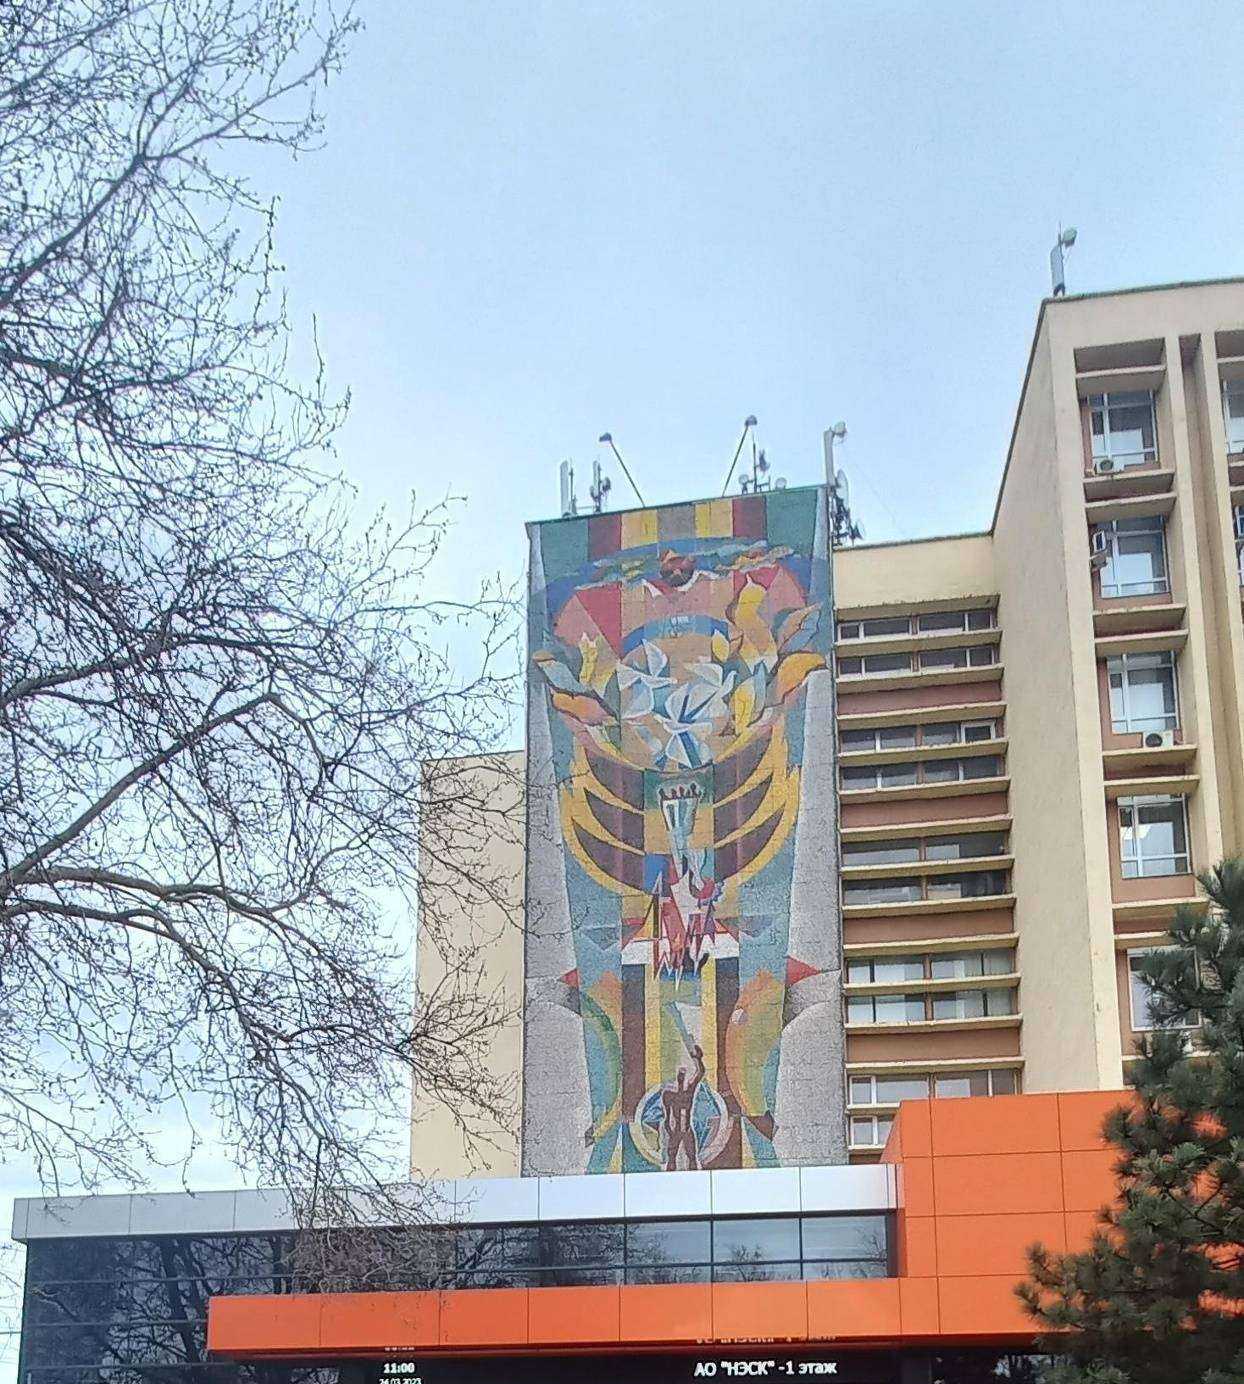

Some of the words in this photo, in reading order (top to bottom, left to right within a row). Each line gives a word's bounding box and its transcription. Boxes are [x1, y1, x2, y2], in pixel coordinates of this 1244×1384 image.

[383, 1362, 415, 1374] 11:00
[694, 1362, 717, 1377] АО
[720, 1360, 775, 1376] "НЭСК"
[798, 1362, 838, 1375] этаж
